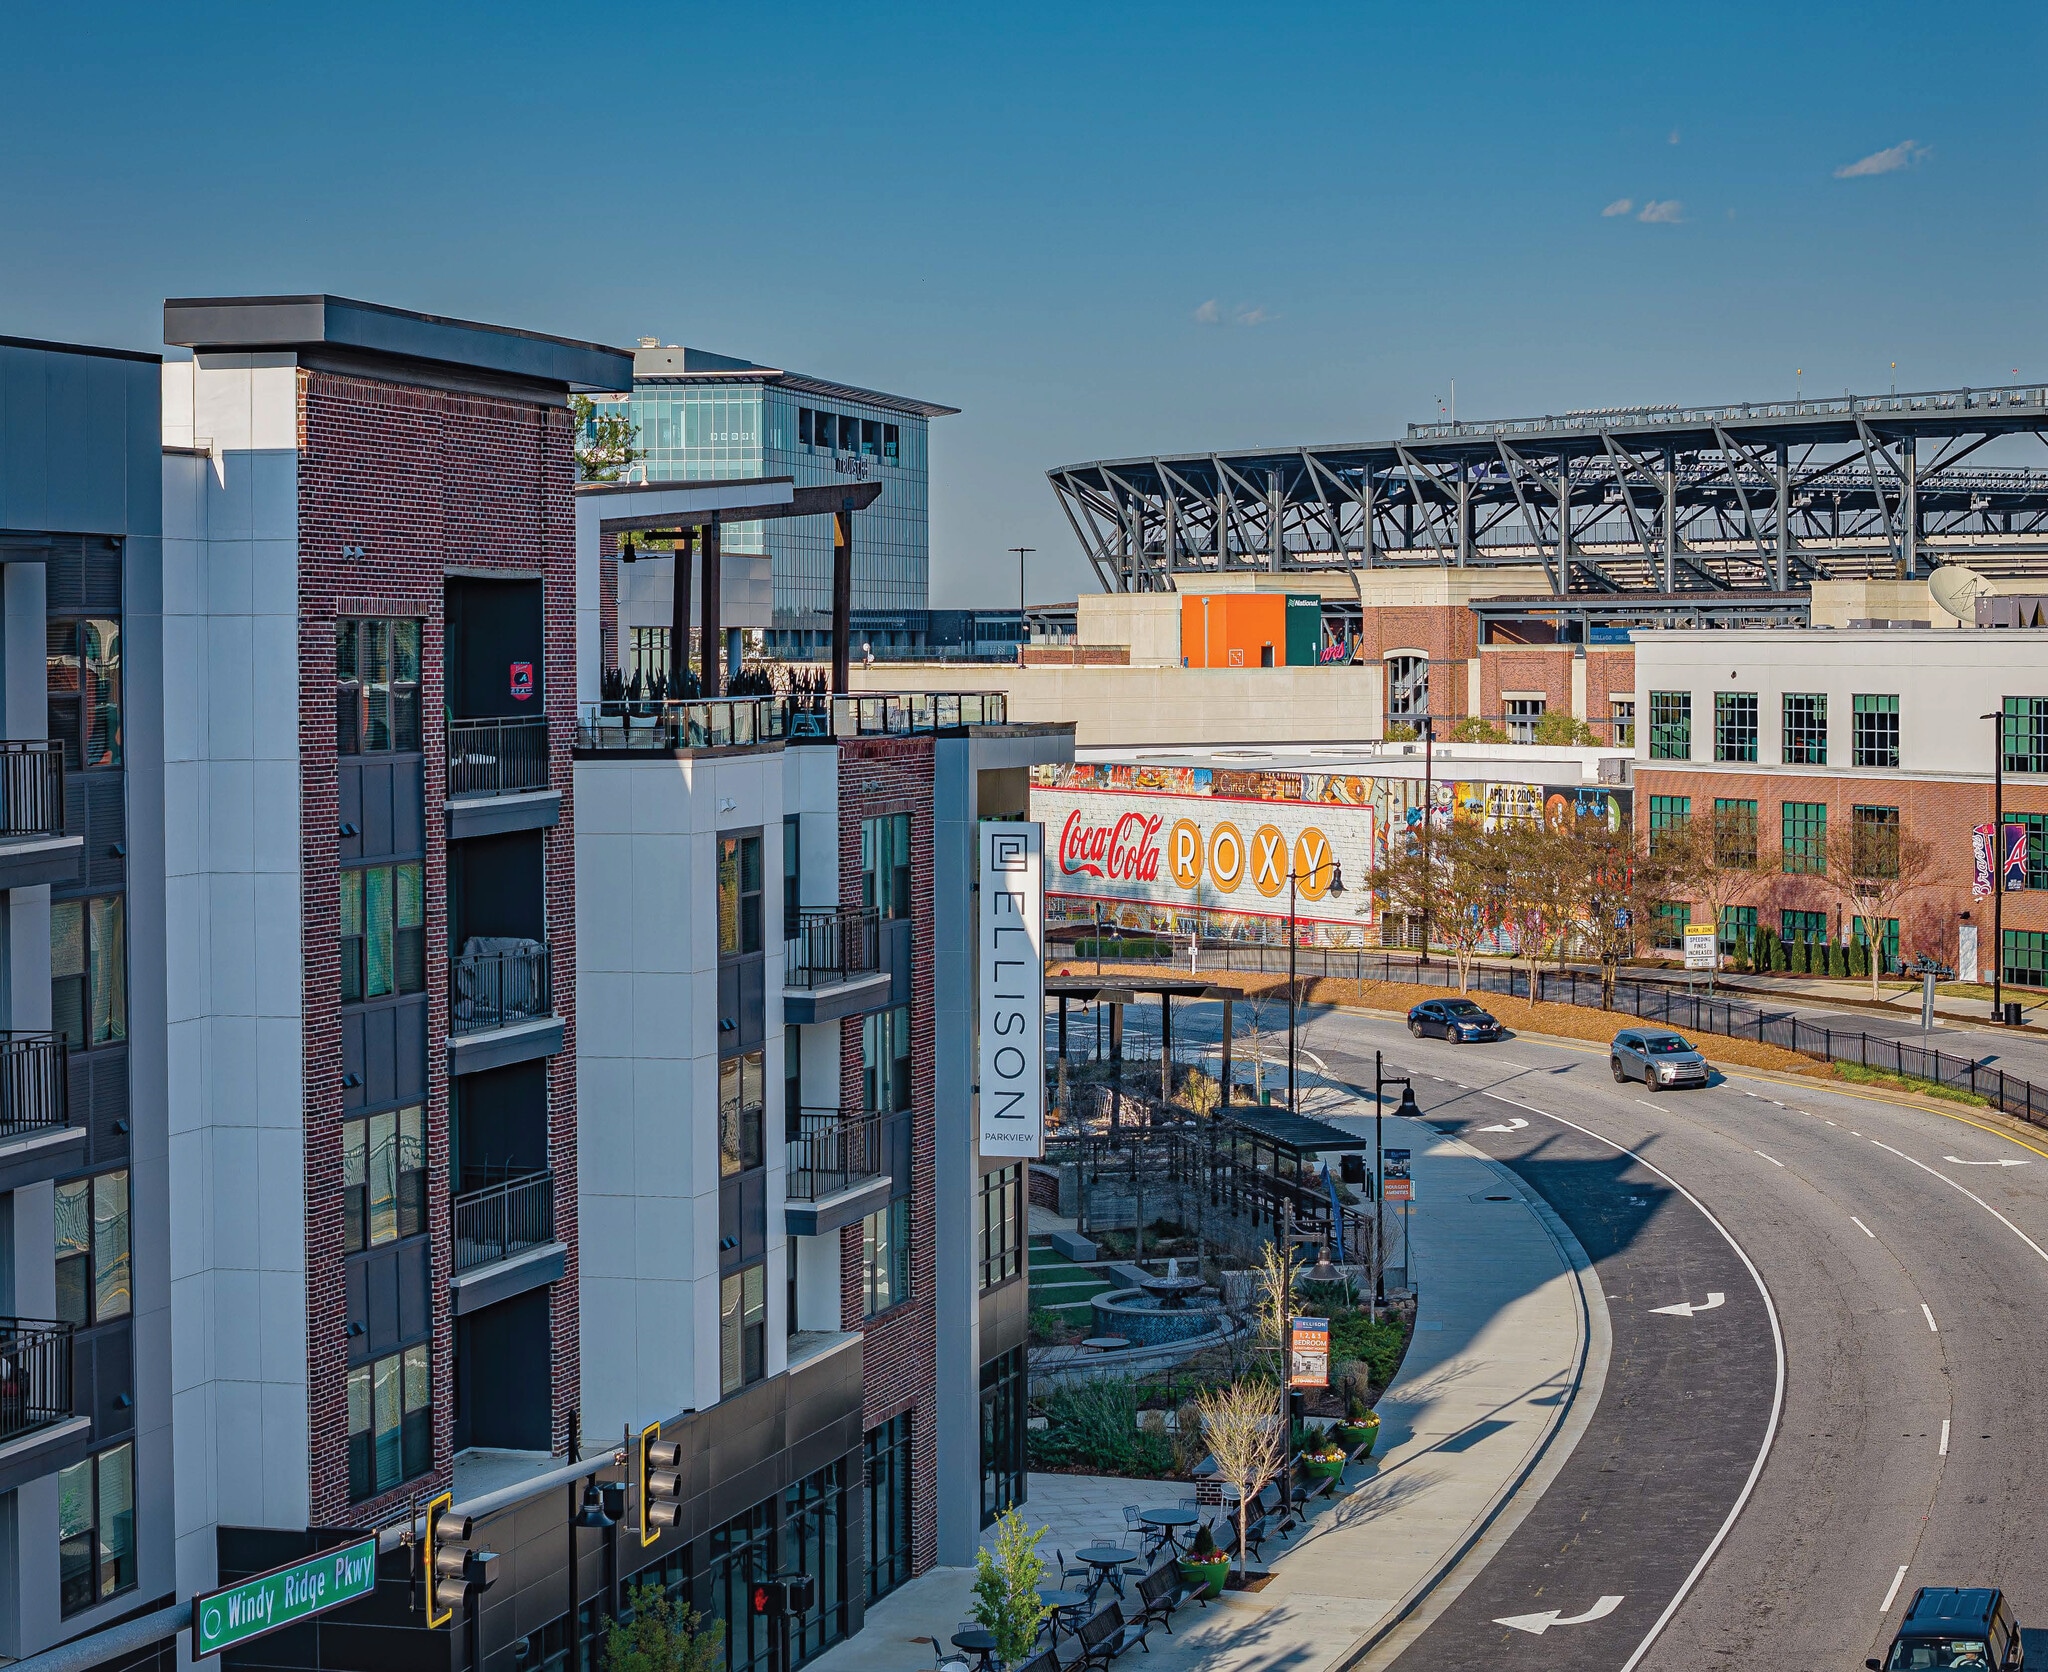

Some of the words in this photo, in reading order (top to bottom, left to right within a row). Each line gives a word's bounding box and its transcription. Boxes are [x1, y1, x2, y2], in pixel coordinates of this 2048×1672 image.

[1294, 599, 1319, 607] National
[1489, 788, 1509, 802] APRIL
[1510, 789, 1515, 803] 3
[1517, 789, 1536, 803] 2009
[1058, 808, 1164, 883] Coca-Cola
[1177, 828, 1324, 890] ROXY
[1972, 834, 1992, 895] Braves
[993, 891, 1026, 1120] ELLISON
[984, 1132, 1034, 1142] PARKVIEW
[228, 1585, 275, 1629] Windy
[285, 1570, 325, 1609] Ridge
[335, 1554, 373, 1590] Pkwy
